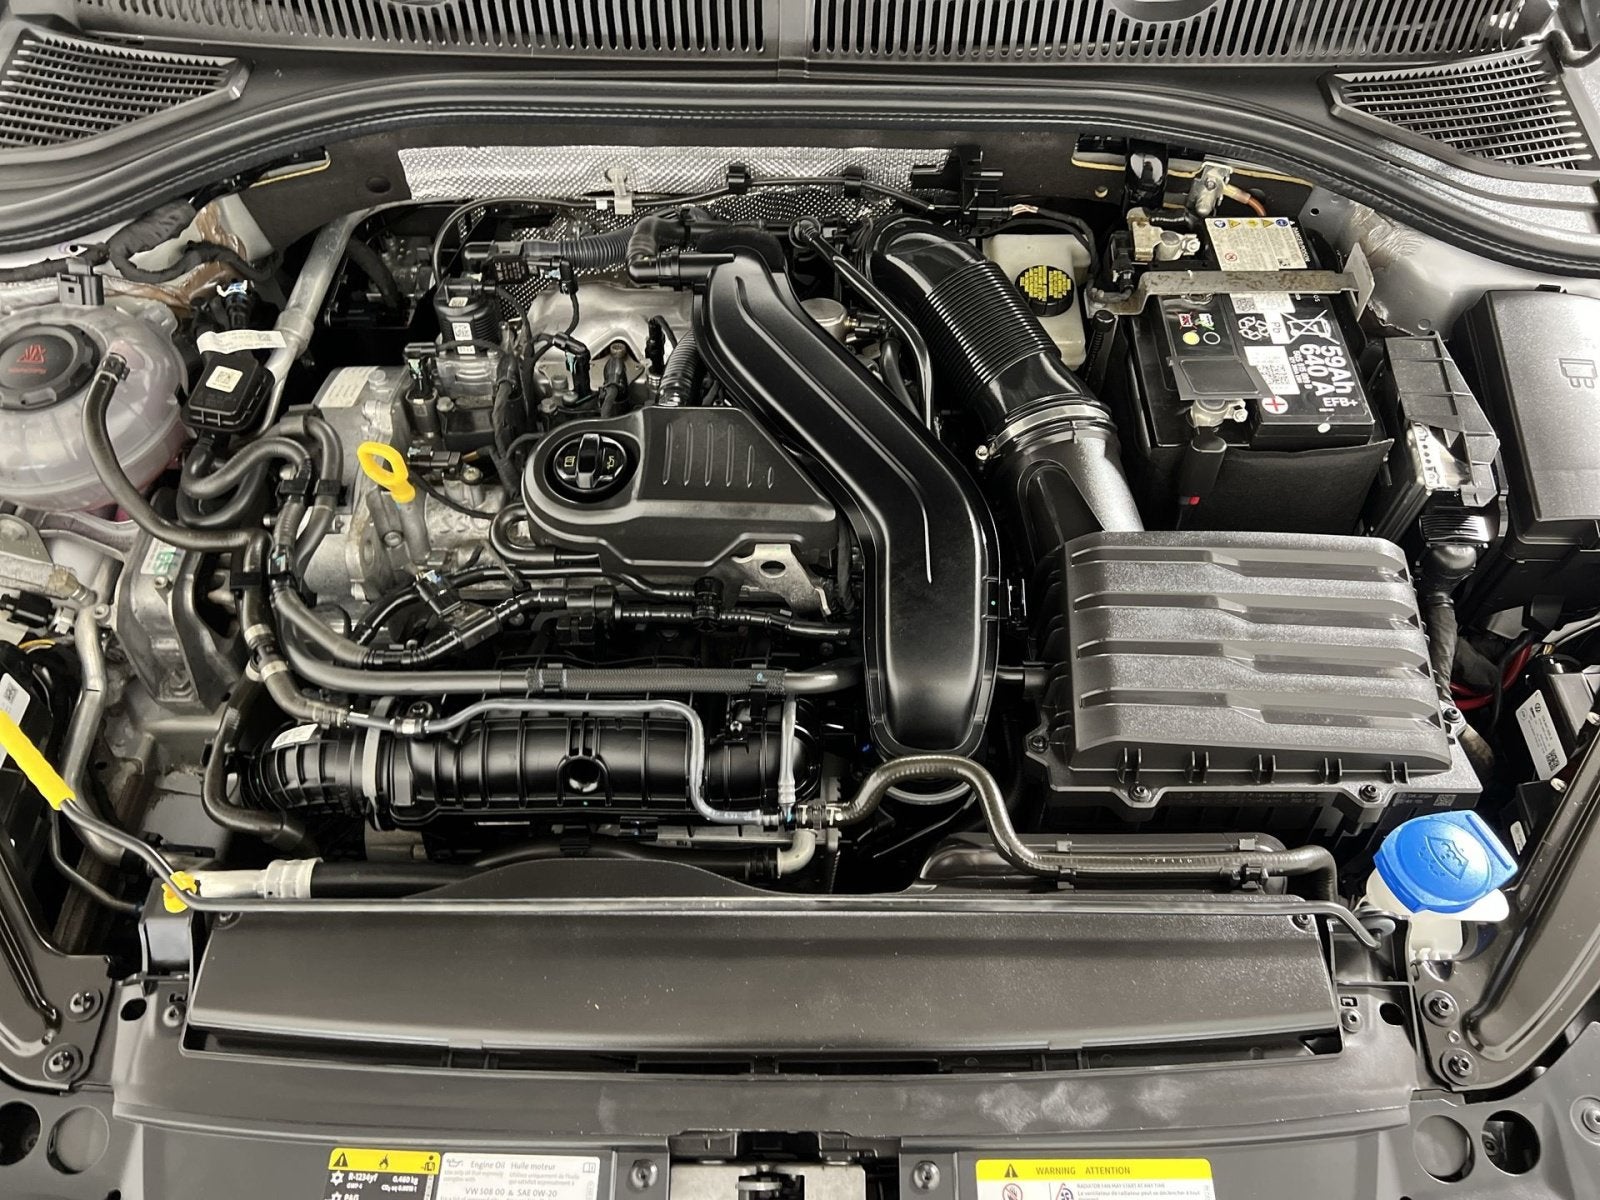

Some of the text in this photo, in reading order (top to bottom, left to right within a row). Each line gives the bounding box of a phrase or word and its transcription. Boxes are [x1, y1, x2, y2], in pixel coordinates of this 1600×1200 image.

[1300, 343, 1329, 377] 640
[1320, 345, 1355, 393] 59Ah
[1311, 381, 1336, 396] A
[1322, 397, 1358, 407] EFB+
[470, 1161, 505, 1169] Engine Oil
[511, 1162, 529, 1170] Huile
[1035, 1167, 1131, 1175] WARNING ATTENTION
[348, 1172, 378, 1184] R-1234yf
[517, 1189, 531, 1197] SAE
